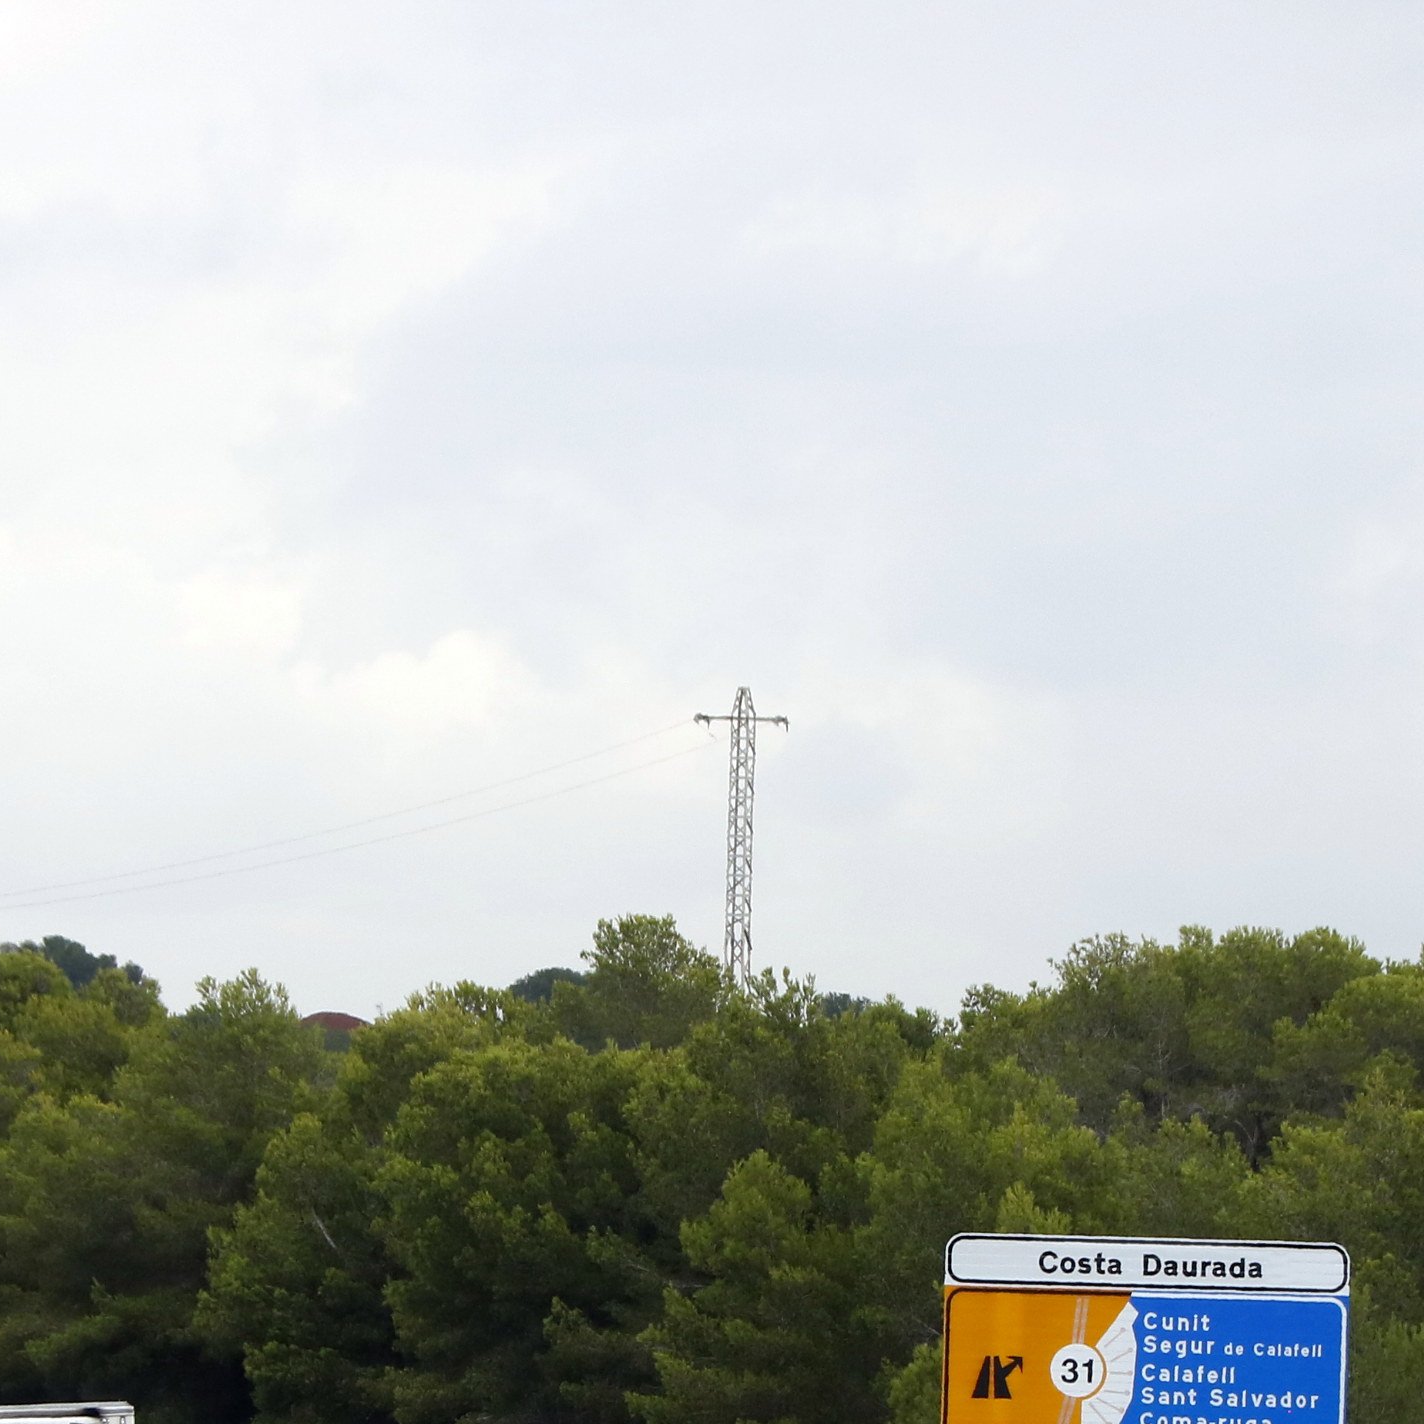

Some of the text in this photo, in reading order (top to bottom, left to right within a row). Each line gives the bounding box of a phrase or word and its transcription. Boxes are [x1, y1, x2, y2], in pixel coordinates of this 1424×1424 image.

[1039, 1251, 1263, 1279] Costa Daurada
[1143, 1312, 1211, 1331] Cunit
[1143, 1336, 1322, 1358] Segur de Calafell
[1061, 1358, 1094, 1384] 31
[1141, 1364, 1236, 1384] Calafell
[1141, 1388, 1318, 1409] Sant Salvador
